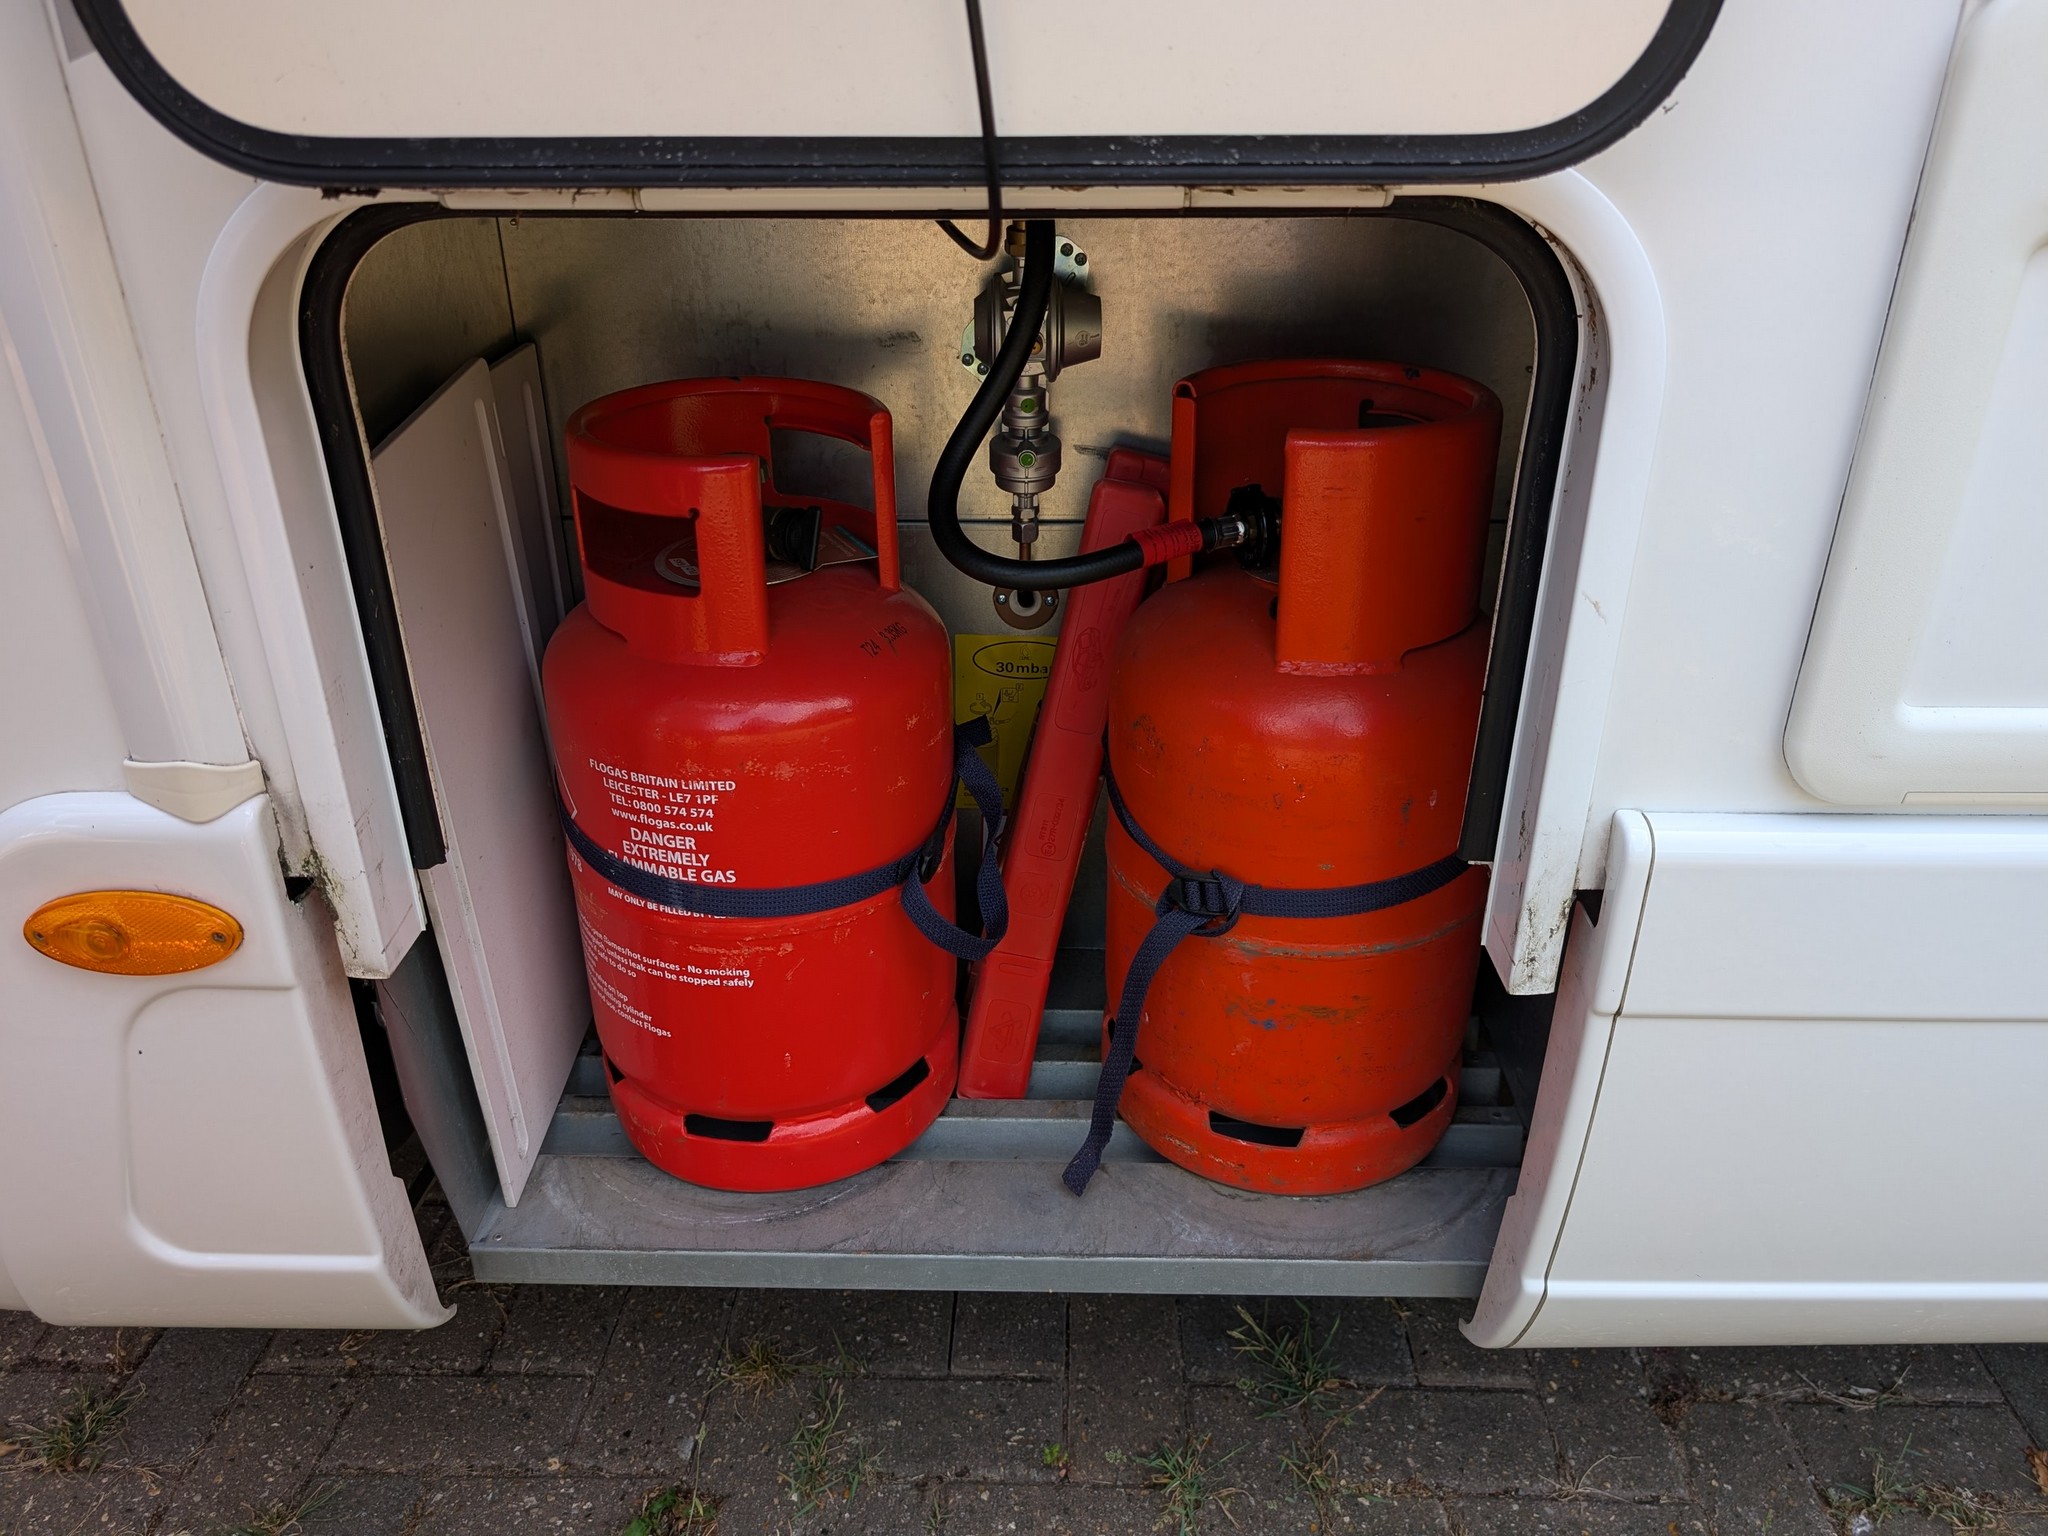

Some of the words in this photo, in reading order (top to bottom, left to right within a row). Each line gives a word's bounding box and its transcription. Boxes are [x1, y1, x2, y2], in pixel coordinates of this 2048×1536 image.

[995, 661, 1014, 673] 30
[1016, 662, 1050, 674] mba
[589, 758, 629, 780] FLOGAS
[630, 771, 679, 789] BRITAIN
[681, 779, 736, 791] LIMITED
[603, 777, 660, 800] LEICESTER
[669, 792, 691, 803] LE7
[695, 794, 719, 805] 1PF
[609, 791, 632, 808] TEL:
[633, 799, 661, 813] 0800
[664, 805, 687, 817] 574
[690, 808, 714, 818] 574
[611, 807, 713, 832] www.flogas.co.uk
[630, 827, 697, 850] DANGER
[622, 840, 710, 867] EXTREMELY
[700, 870, 737, 883] GAS
[607, 886, 623, 900] MAY
[624, 894, 646, 908] ONLY
[647, 901, 659, 911] BE
[616, 963, 627, 974] do
[627, 969, 637, 978] so
[628, 959, 646, 972] leak
[647, 967, 663, 977] can
[664, 970, 677, 980] be
[678, 975, 721, 986] stopped
[722, 978, 754, 988] safely
[642, 956, 680, 971] surfaces
[688, 965, 702, 974] No
[704, 967, 750, 978] smoking
[617, 1008, 643, 1028] contact
[643, 1021, 672, 1038] Flogas
[622, 1003, 653, 1022] cylinder
